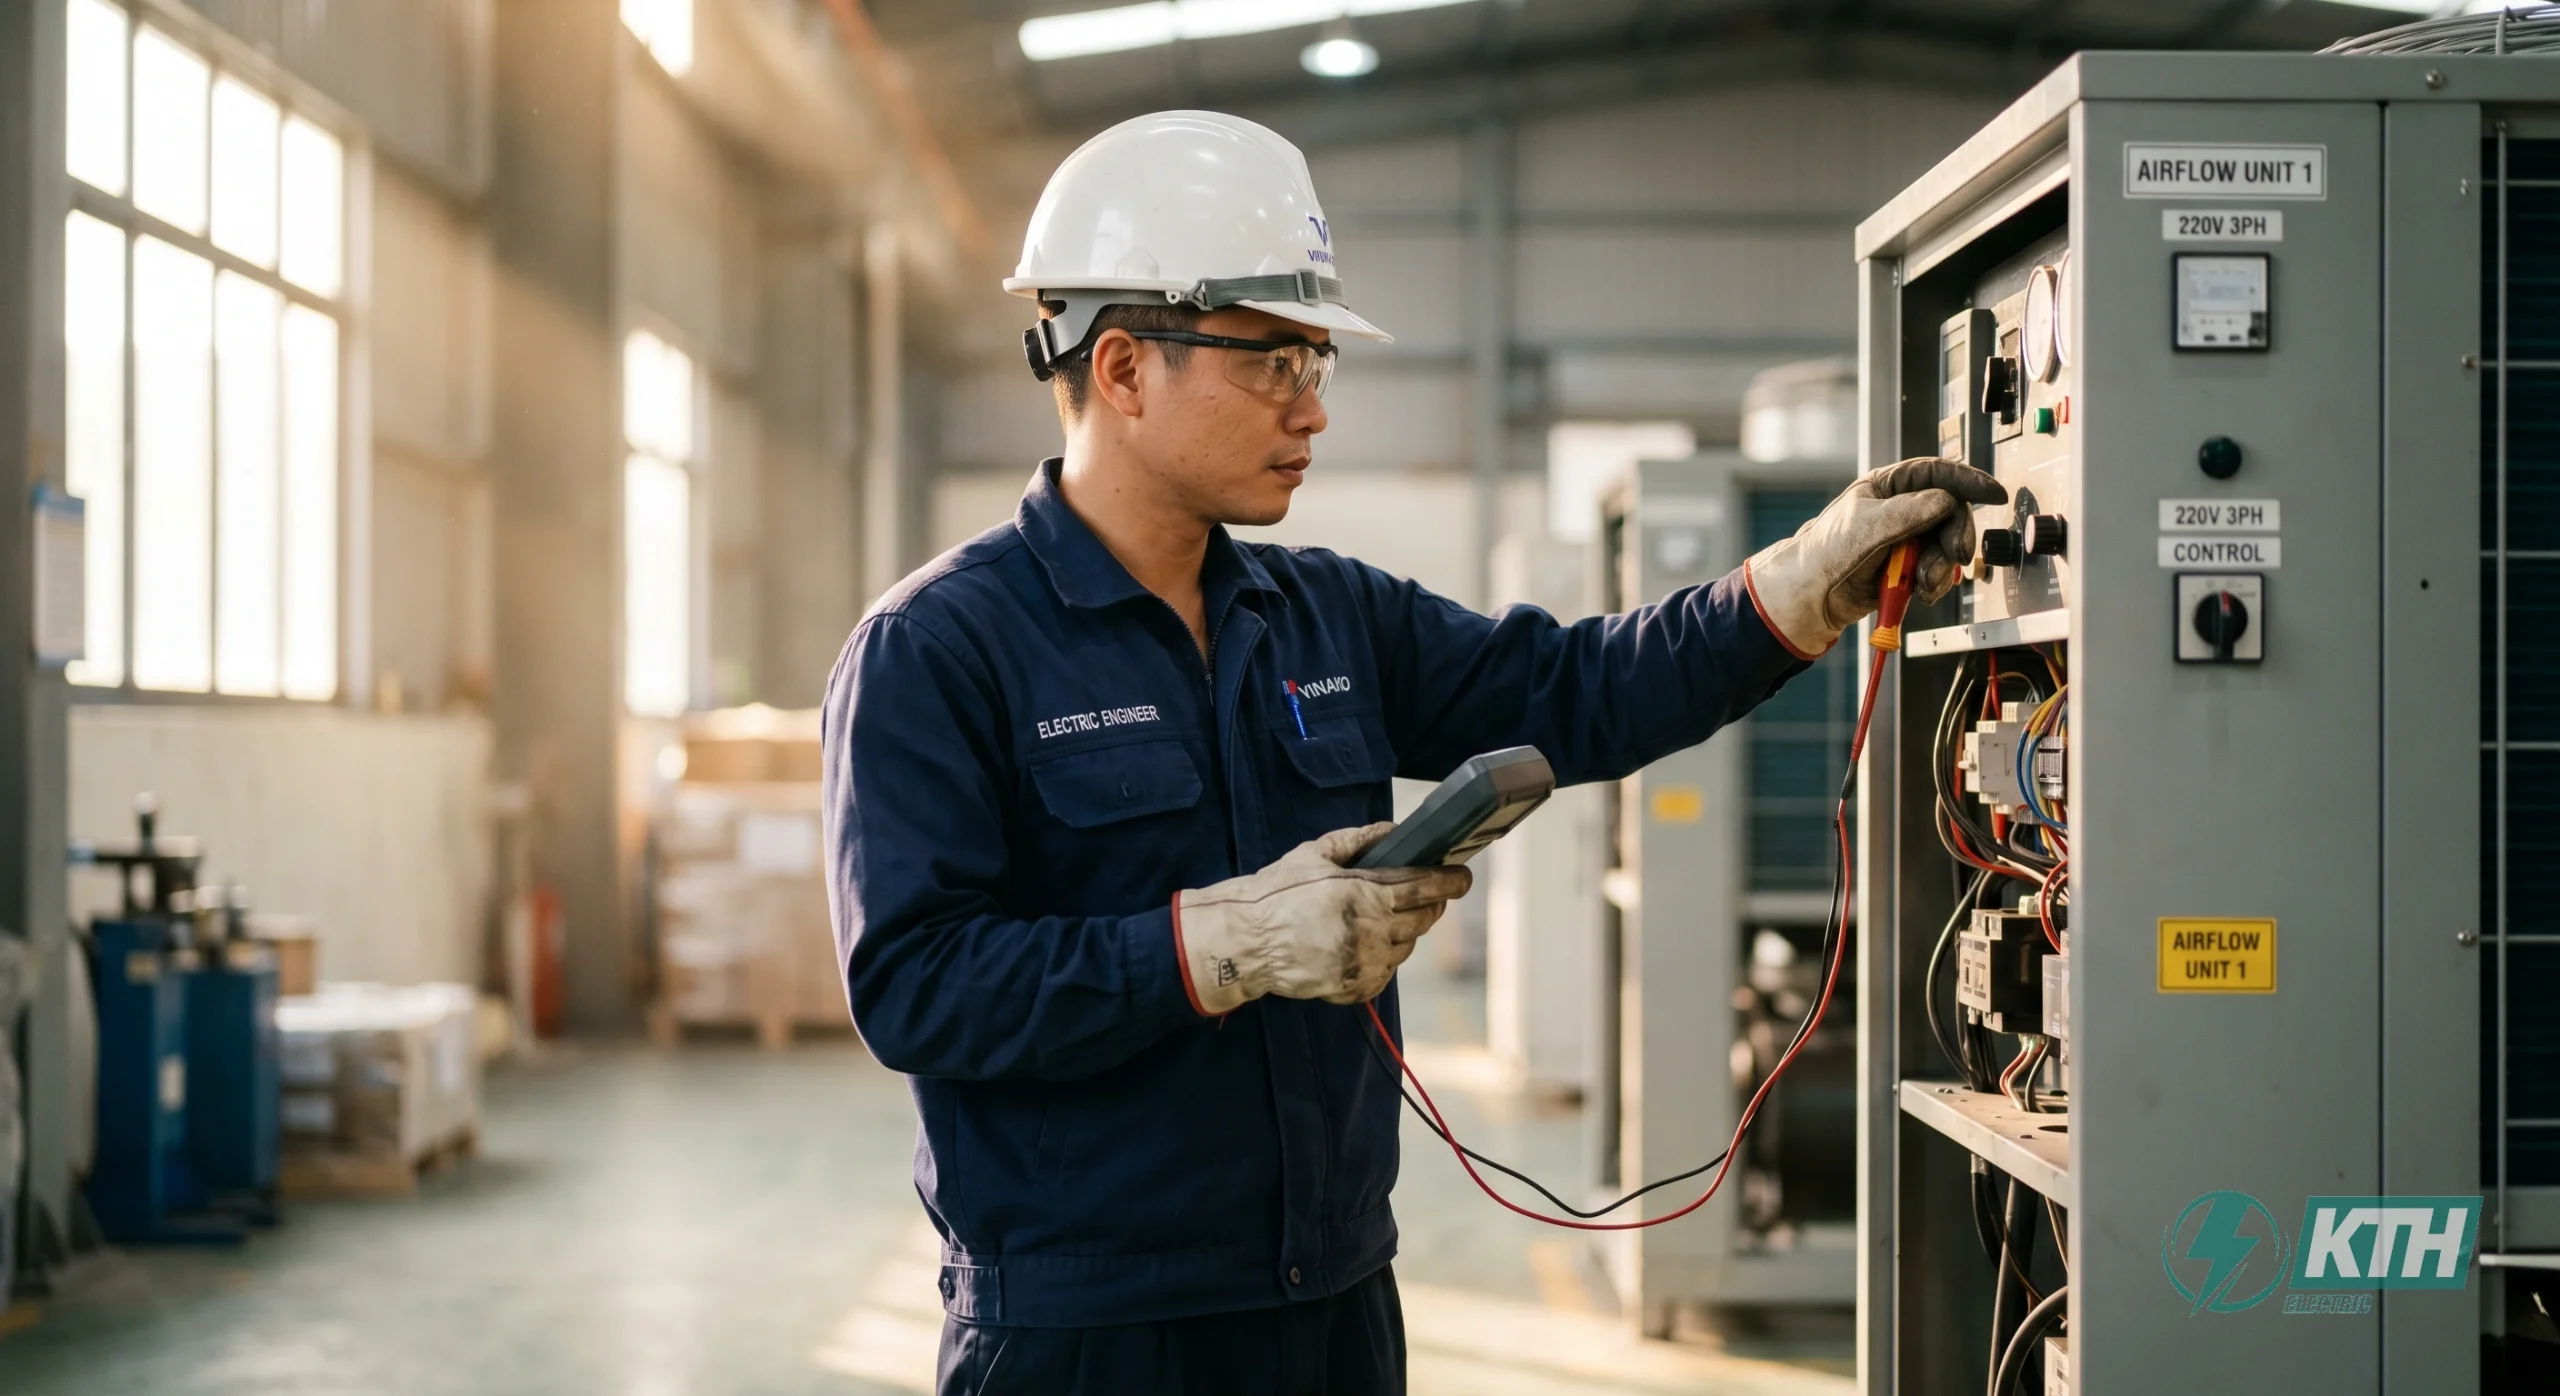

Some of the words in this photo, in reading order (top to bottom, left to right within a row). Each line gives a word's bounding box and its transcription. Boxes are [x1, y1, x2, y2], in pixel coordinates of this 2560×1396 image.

[2137, 159, 2237, 182] AIRFLOW
[2244, 161, 2295, 183] UNIT
[2302, 162, 2312, 183] 1
[2179, 216, 2224, 235] 220V
[2230, 217, 2267, 236] 3PH
[2175, 506, 2220, 526] 220V
[2226, 506, 2264, 526] 3PH
[2173, 543, 2266, 562] CONTROL
[1296, 676, 1351, 699] VINAKO
[1037, 712, 1100, 739] ELECTRIC
[1101, 705, 1160, 727] ENGINEER
[2173, 931, 2261, 951] AIRFLOW
[2185, 960, 2231, 979] UNIT
[2236, 961, 2247, 979] 1
